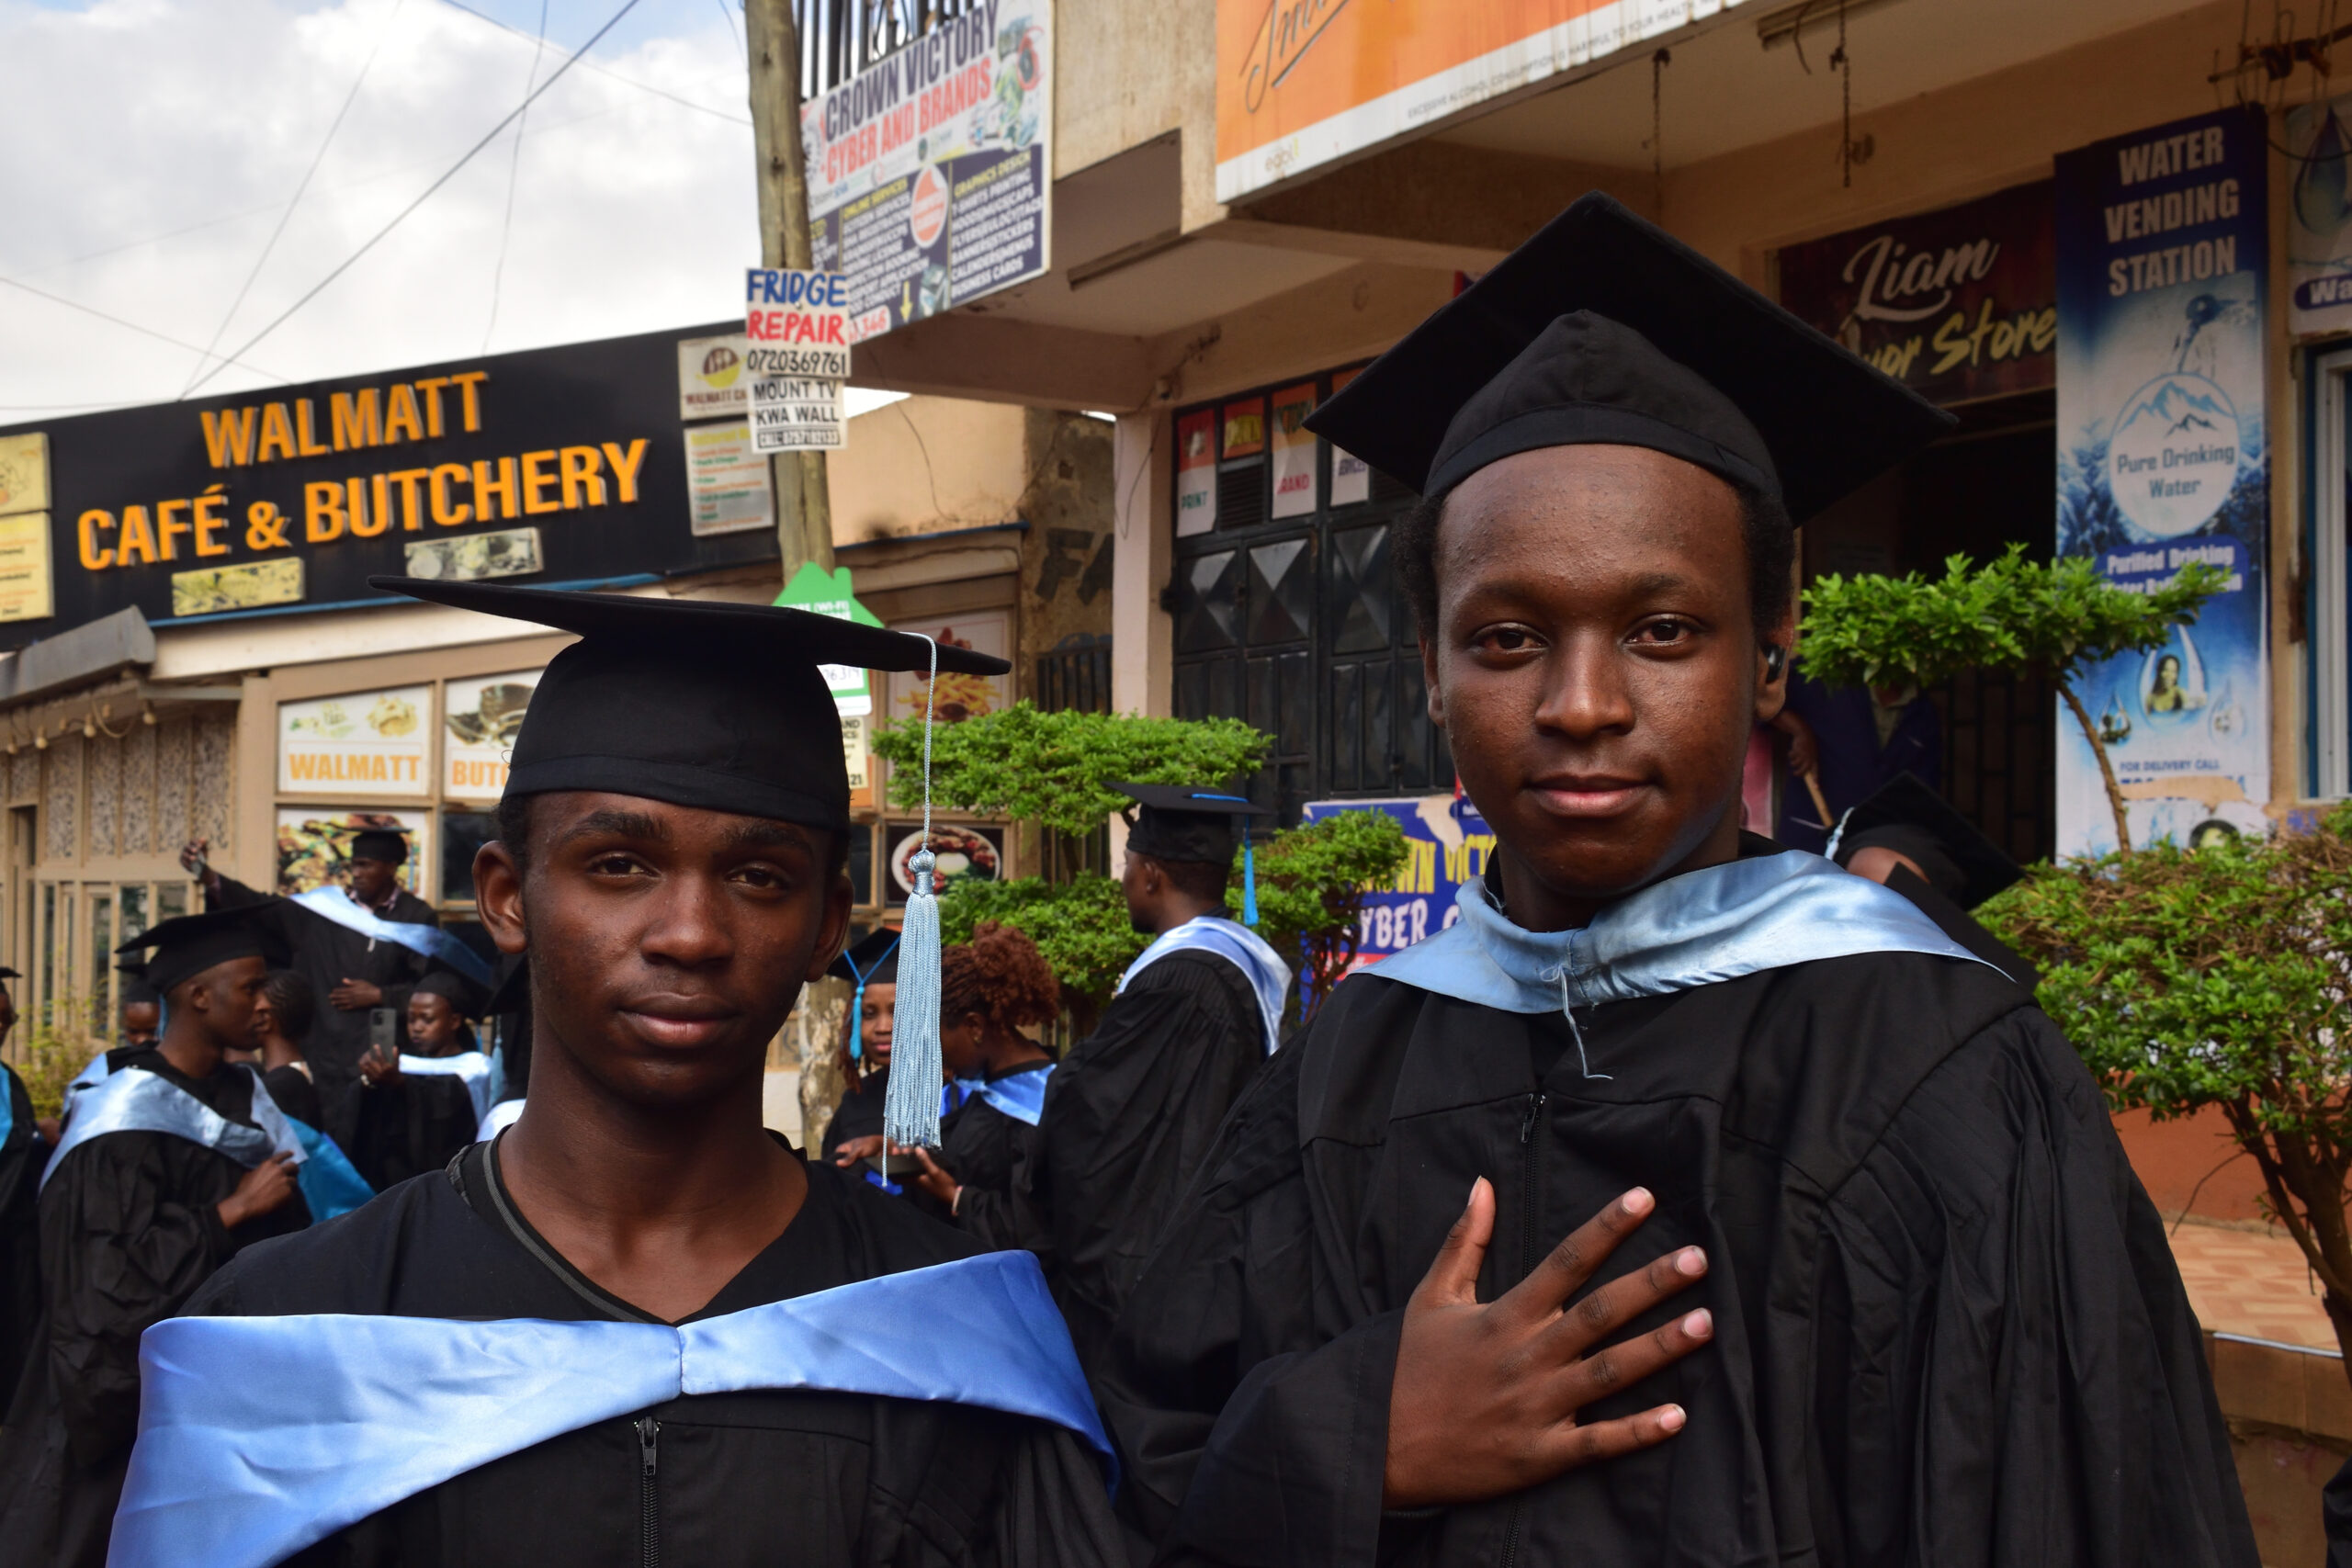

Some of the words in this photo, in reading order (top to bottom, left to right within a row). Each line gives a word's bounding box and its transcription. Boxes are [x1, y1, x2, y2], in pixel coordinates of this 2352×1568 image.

[826, 56, 899, 141] CROWN
[906, 0, 997, 96] VICTORY
[1449, 82, 1488, 105] ALCOHOL
[1490, 58, 1555, 89] CONSUMPTION
[1569, 34, 1611, 58] HARMFUL
[1613, 27, 1626, 41] TO
[1628, 17, 1654, 35] YOUR
[827, 121, 876, 184] CYBER
[881, 101, 914, 156] AND
[920, 57, 991, 134] BRANDS
[2118, 125, 2224, 186] WATER
[954, 165, 997, 199] GRAPHICS
[2104, 178, 2239, 244] VENDING
[992, 255, 1023, 280] CARDS
[1841, 234, 2001, 321] Liam
[2109, 235, 2236, 297] STATION
[747, 269, 846, 307] FRIDGE
[2309, 278, 2352, 305] Wa
[747, 310, 845, 345] REPAIR
[747, 349, 845, 375] 0720369761
[753, 380, 810, 401] MOUNT
[817, 380, 837, 399] TV
[201, 372, 488, 468] WALMATT
[755, 407, 790, 425] KWA
[795, 405, 840, 423] WALL
[2117, 453, 2157, 474] Pure
[2163, 444, 2235, 469] Drinking
[77, 485, 232, 570] CAFÉ
[245, 502, 290, 549] &
[305, 438, 649, 544] BUTCHERY
[1182, 491, 1208, 511] PRINT
[2148, 479, 2201, 499] Water
[288, 754, 421, 781] WALMATT
[2120, 761, 2140, 772] FOR
[2143, 761, 2191, 771] DELIVERY
[2195, 759, 2220, 770] CALL
[1360, 897, 1428, 949] YBER
